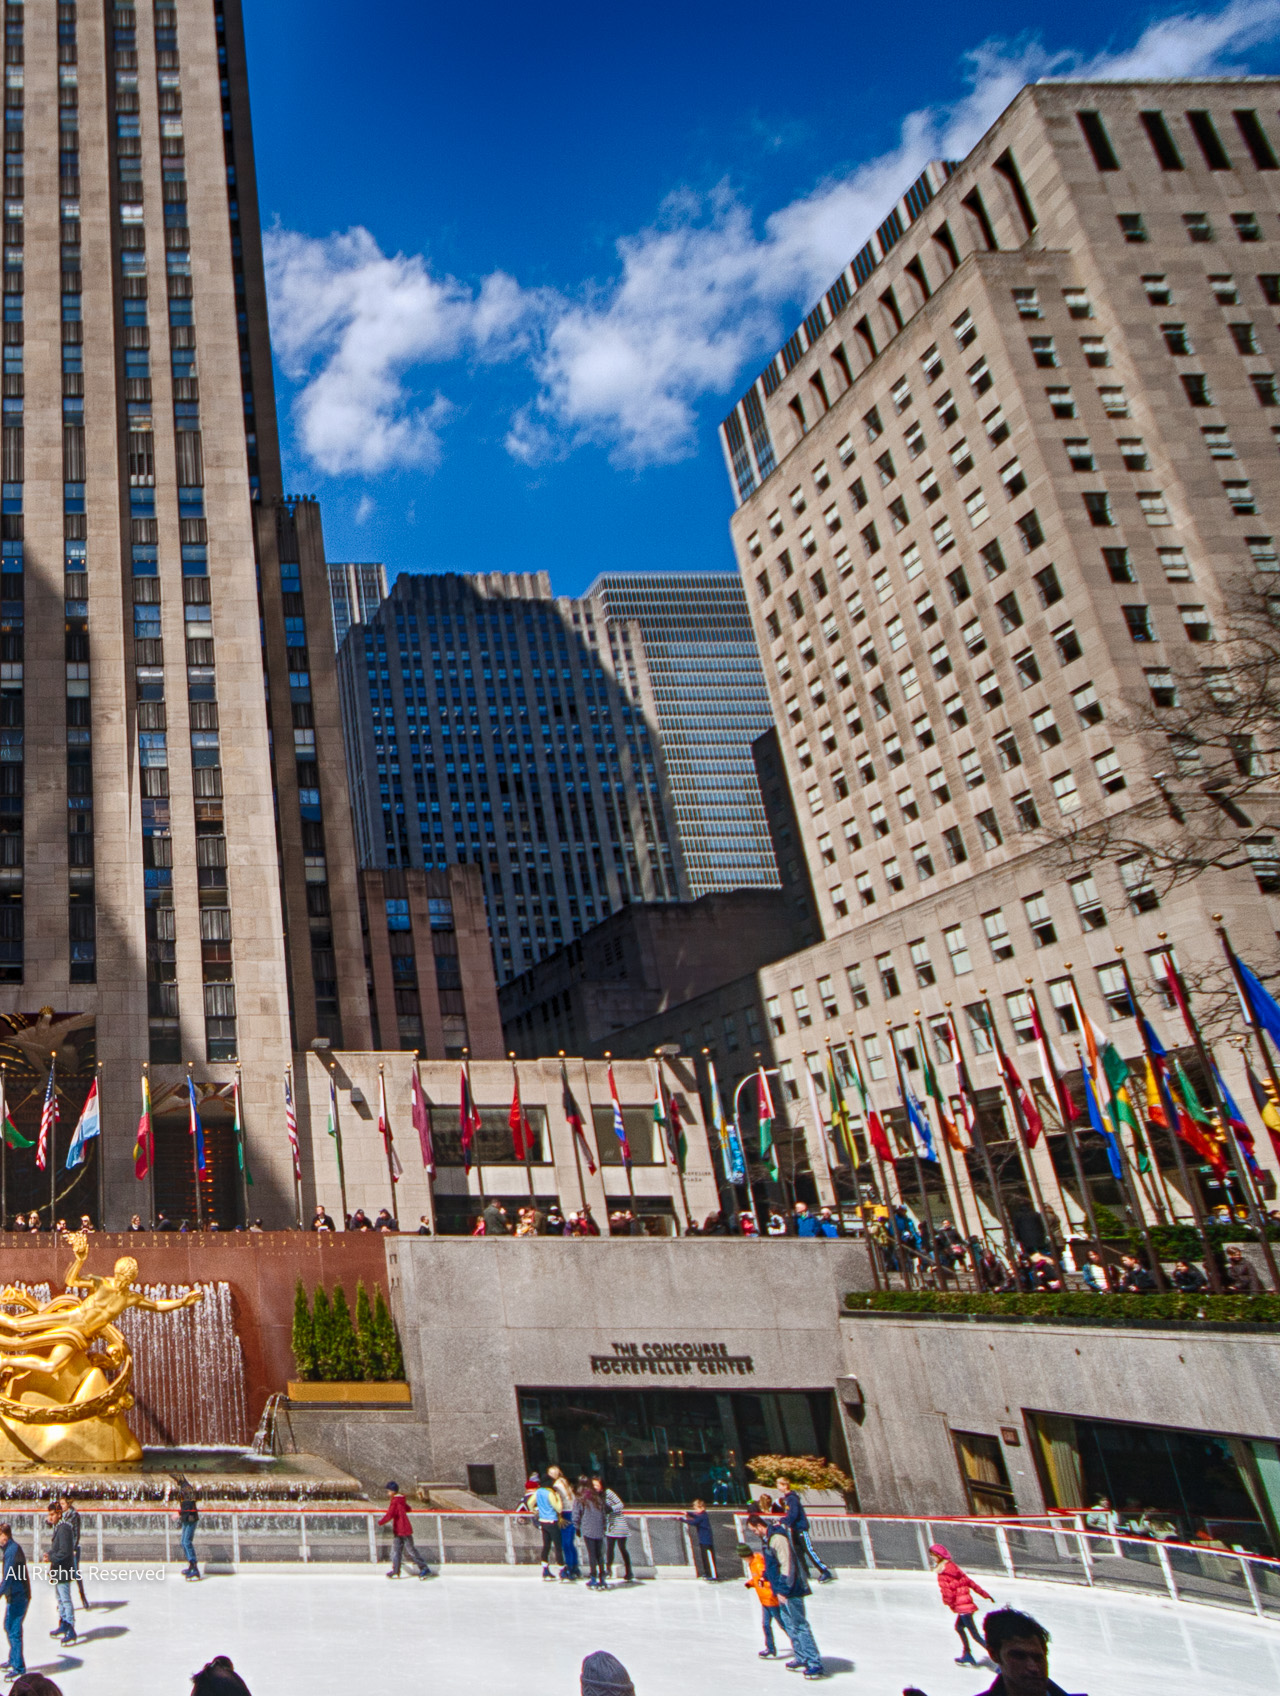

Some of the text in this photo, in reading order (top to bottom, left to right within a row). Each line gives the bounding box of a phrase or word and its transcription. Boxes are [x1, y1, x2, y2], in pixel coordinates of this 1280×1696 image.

[611, 1343, 729, 1357] THE CONCOURSE
[591, 1361, 756, 1375] ROCKEFELLER CENTER
